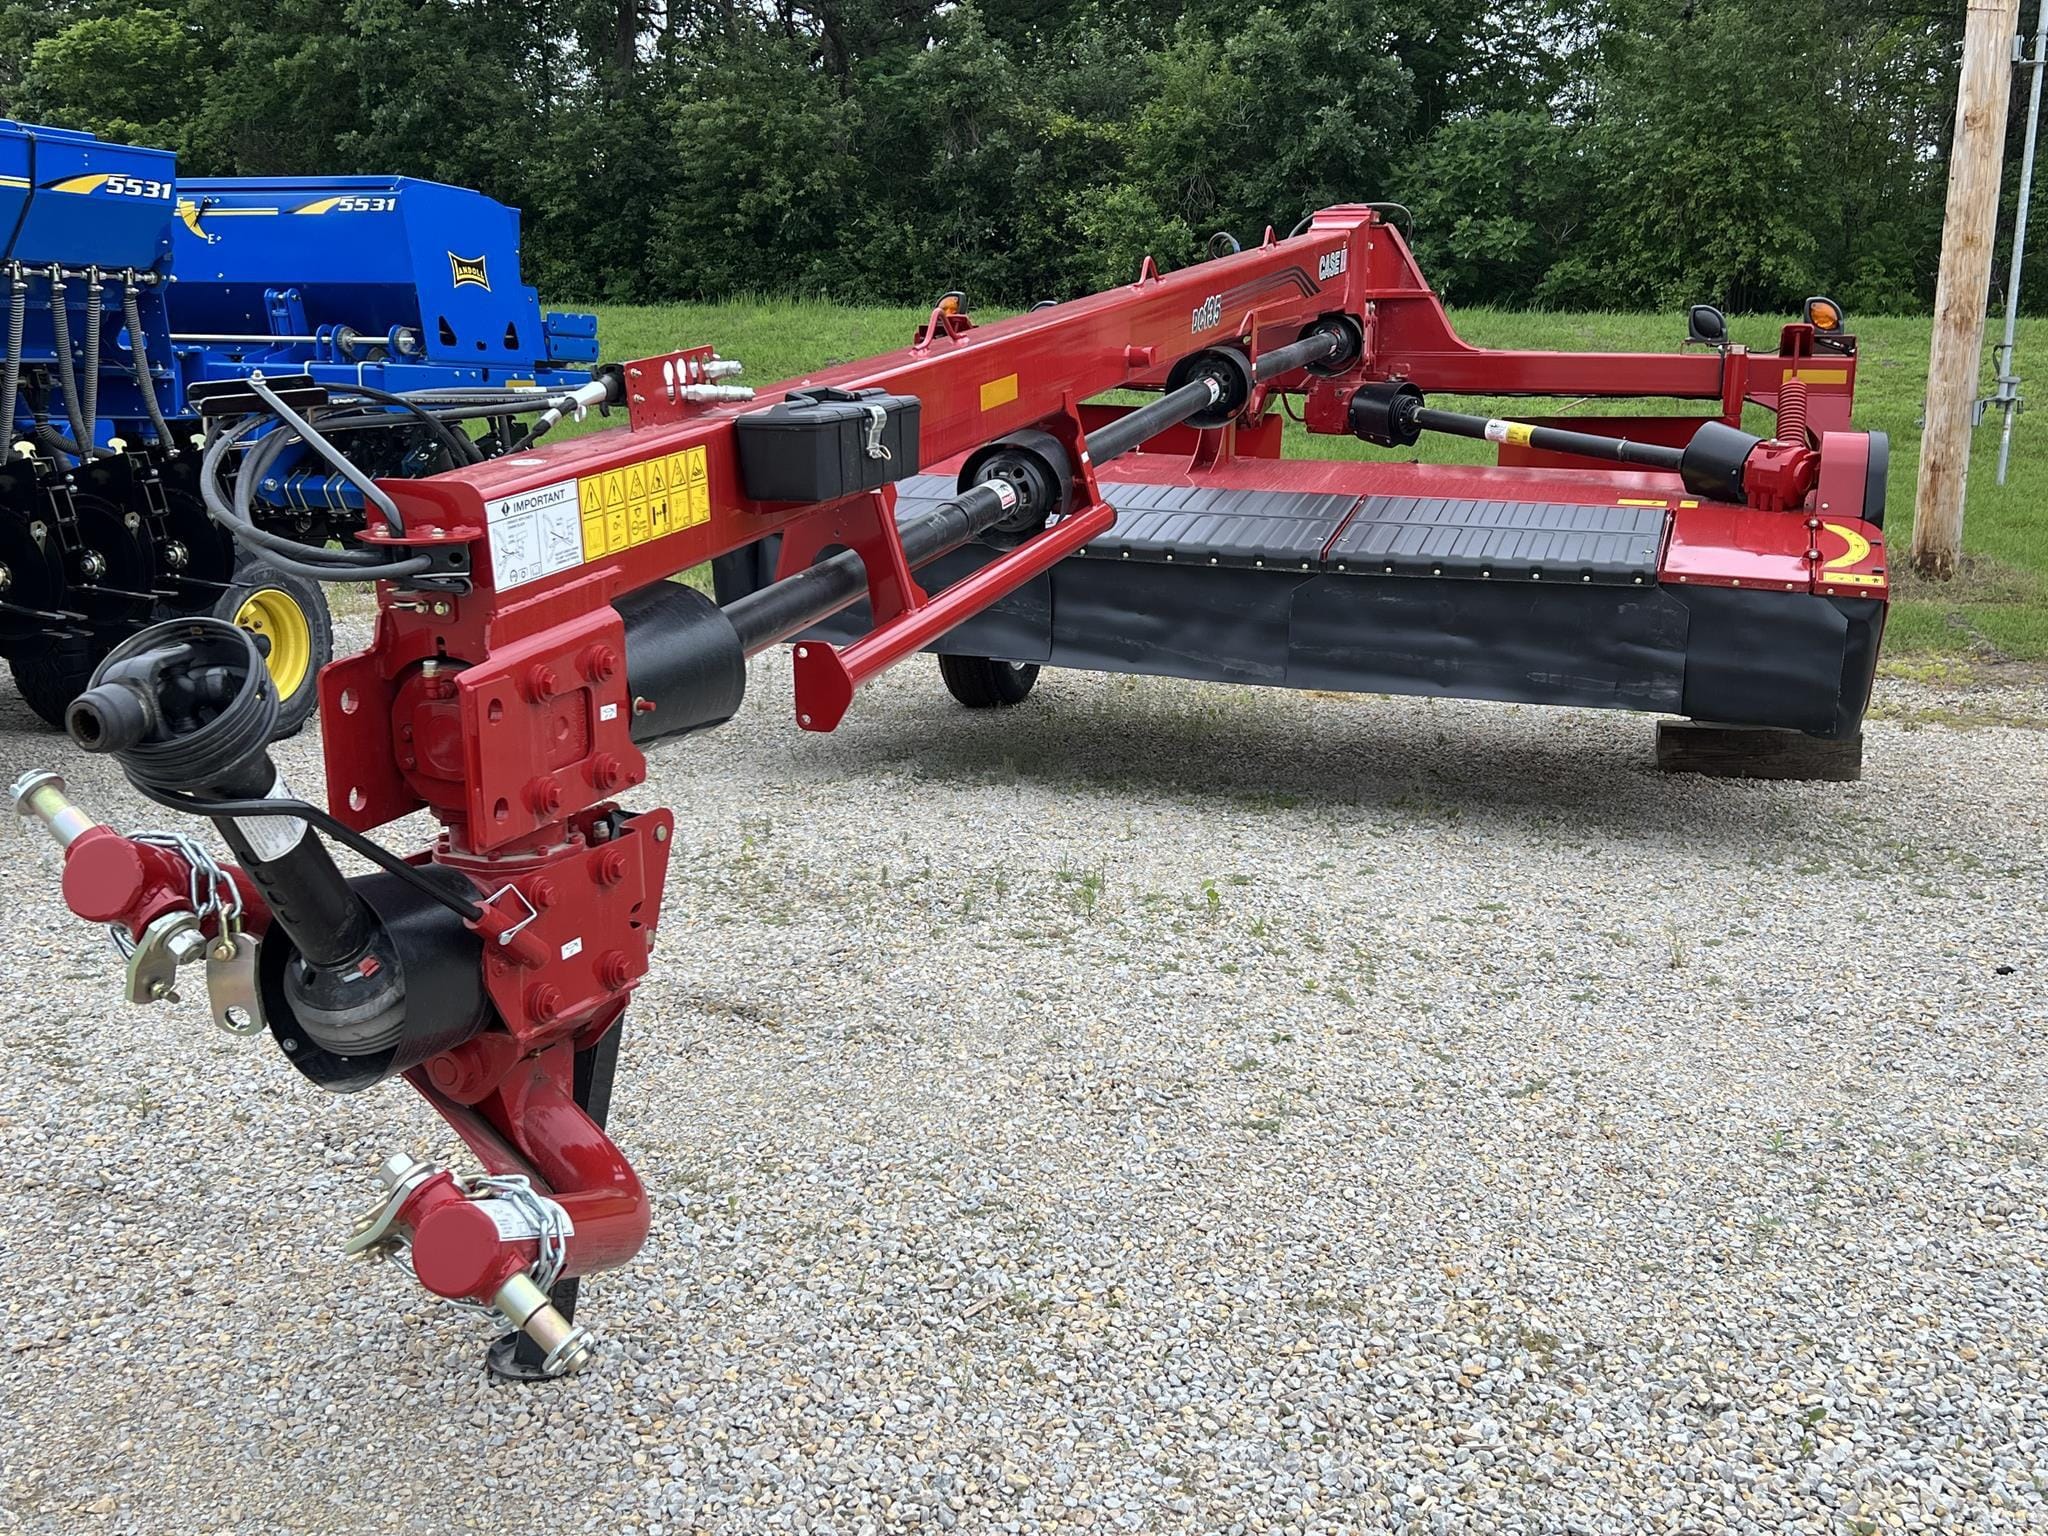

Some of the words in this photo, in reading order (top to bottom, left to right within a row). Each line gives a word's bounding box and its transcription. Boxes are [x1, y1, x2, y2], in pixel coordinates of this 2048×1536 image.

[105, 176, 172, 200] 5531
[337, 198, 396, 212] 5531
[207, 233, 216, 244] E
[453, 259, 486, 284] LANDOLL
[1318, 250, 1341, 281] CASE
[513, 489, 565, 513] IMPORTANT
